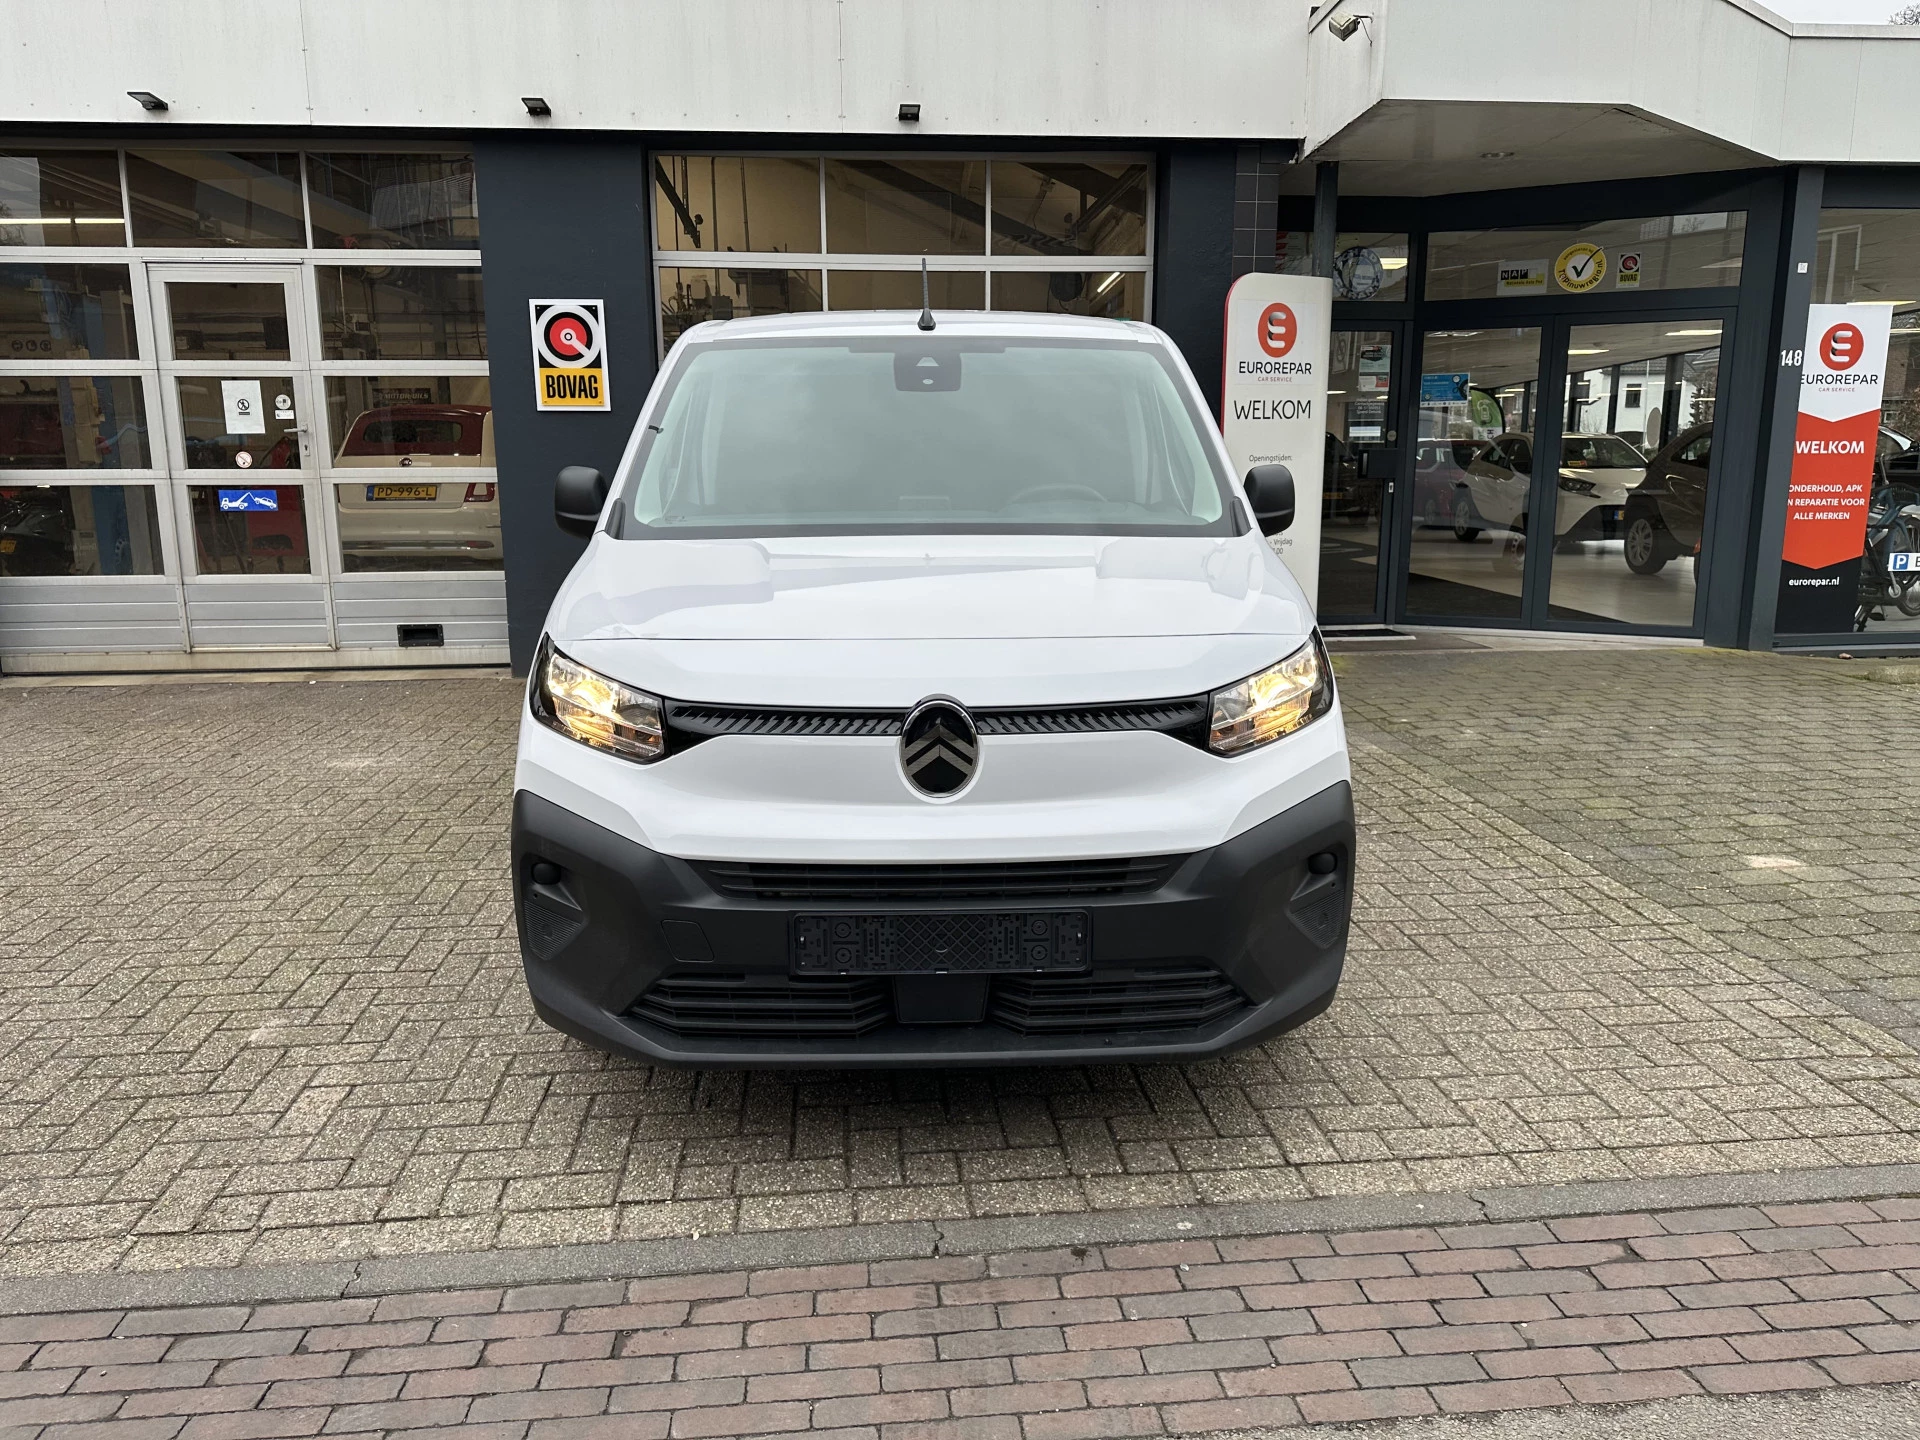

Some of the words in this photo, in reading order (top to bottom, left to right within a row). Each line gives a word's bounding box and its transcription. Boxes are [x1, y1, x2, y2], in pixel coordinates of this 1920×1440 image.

[1501, 269, 1528, 279] NAP
[1619, 274, 1638, 282] BOVAG
[1781, 350, 1803, 367] 148
[1238, 361, 1312, 375] EUROREPAR
[1800, 374, 1878, 385] EUROREPAR
[545, 374, 599, 399] BOVAG
[1234, 400, 1311, 420] WELKOM
[1795, 440, 1865, 454] WELKOM
[1248, 454, 1293, 463] Openingstijden:
[377, 487, 432, 497] PD-996-L
[1788, 484, 1844, 493] ONDERHOUD,
[1845, 484, 1863, 492] APK
[1795, 498, 1839, 506] REPARATIE
[1840, 498, 1865, 506] VOOR
[1793, 512, 1814, 520] ALLE
[1815, 512, 1850, 520] MERKEN
[1273, 538, 1293, 546] Vrijdag
[1788, 577, 1840, 588] eurorepar.nl
